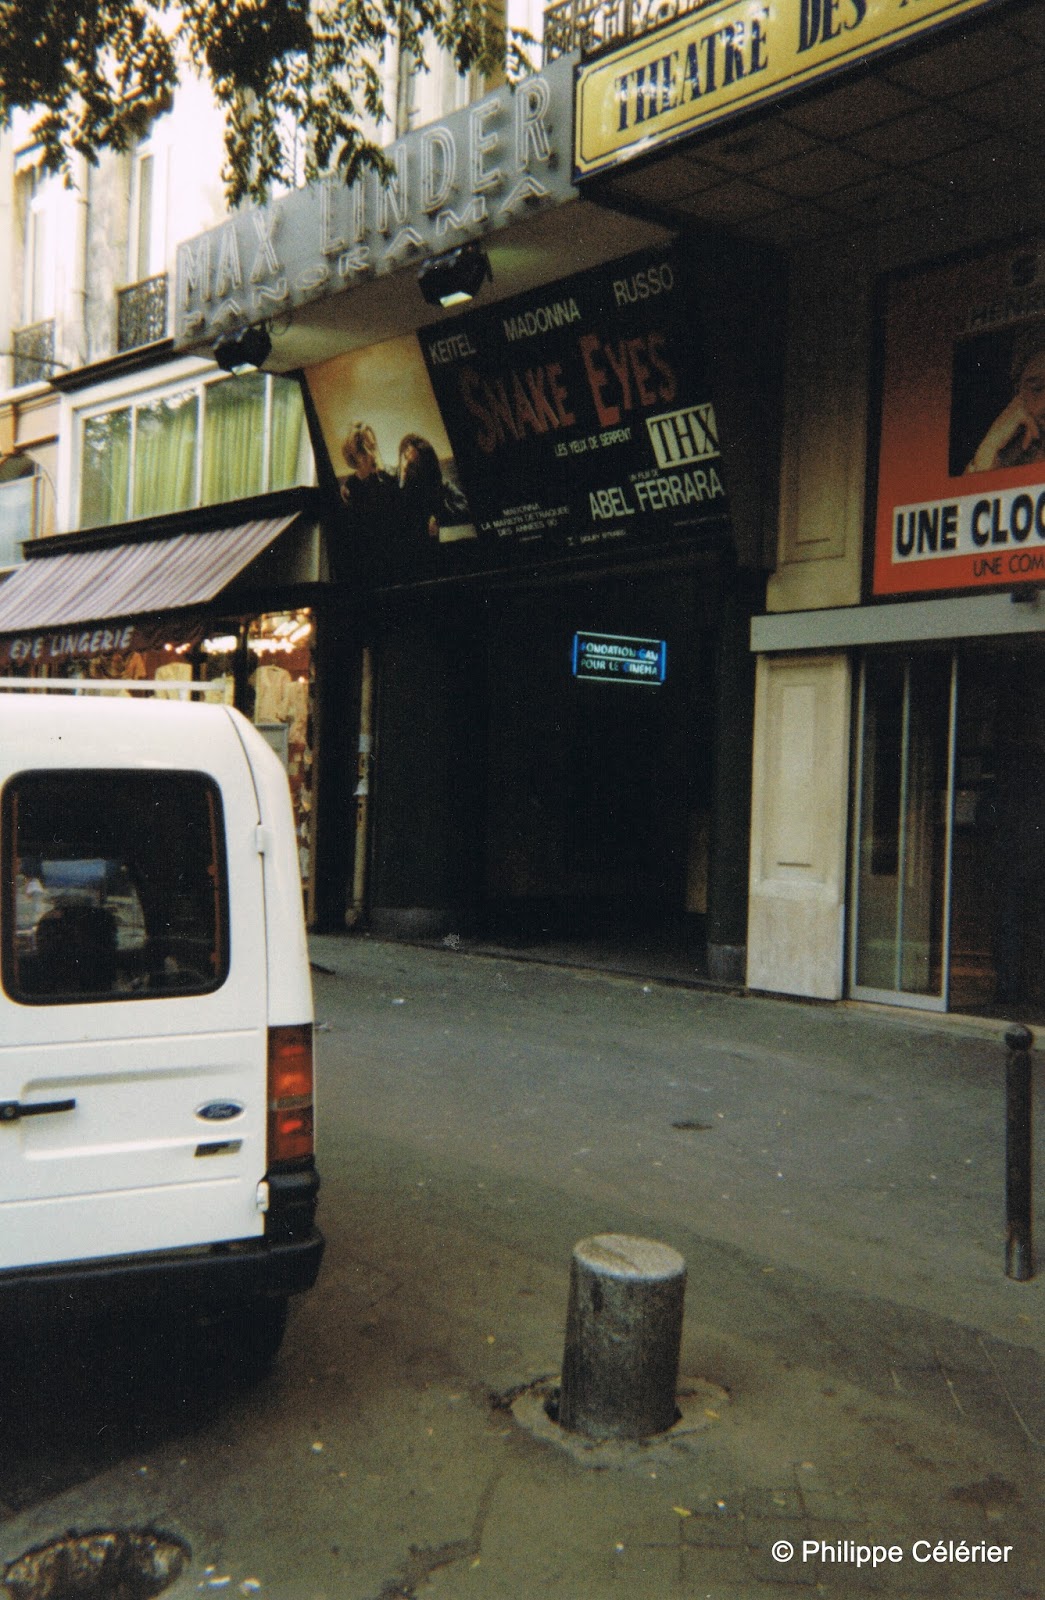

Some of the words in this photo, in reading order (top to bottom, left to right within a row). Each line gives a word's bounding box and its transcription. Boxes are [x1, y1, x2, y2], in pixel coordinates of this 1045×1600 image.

[178, 204, 283, 302] MAX
[320, 77, 552, 256] LINDER
[429, 333, 478, 365] KEITEL
[503, 298, 582, 342] MADONNA
[613, 263, 674, 305] RUSSO
[459, 362, 576, 454] SNAKE
[579, 329, 678, 428] EYES
[588, 435, 599, 450] DE
[599, 427, 632, 448] SERPENT
[650, 406, 720, 464] THX
[589, 486, 635, 521] ABEL
[634, 467, 726, 512] FERRARA
[896, 505, 958, 557] UNE
[973, 556, 1002, 578] UNE
[50, 625, 135, 657] LINGERIE
[581, 642, 636, 657] FONDATION
[637, 648, 659, 661] GAN
[581, 659, 606, 670] POUR
[608, 661, 619, 671] LE
[623, 662, 658, 675] CINEMA
